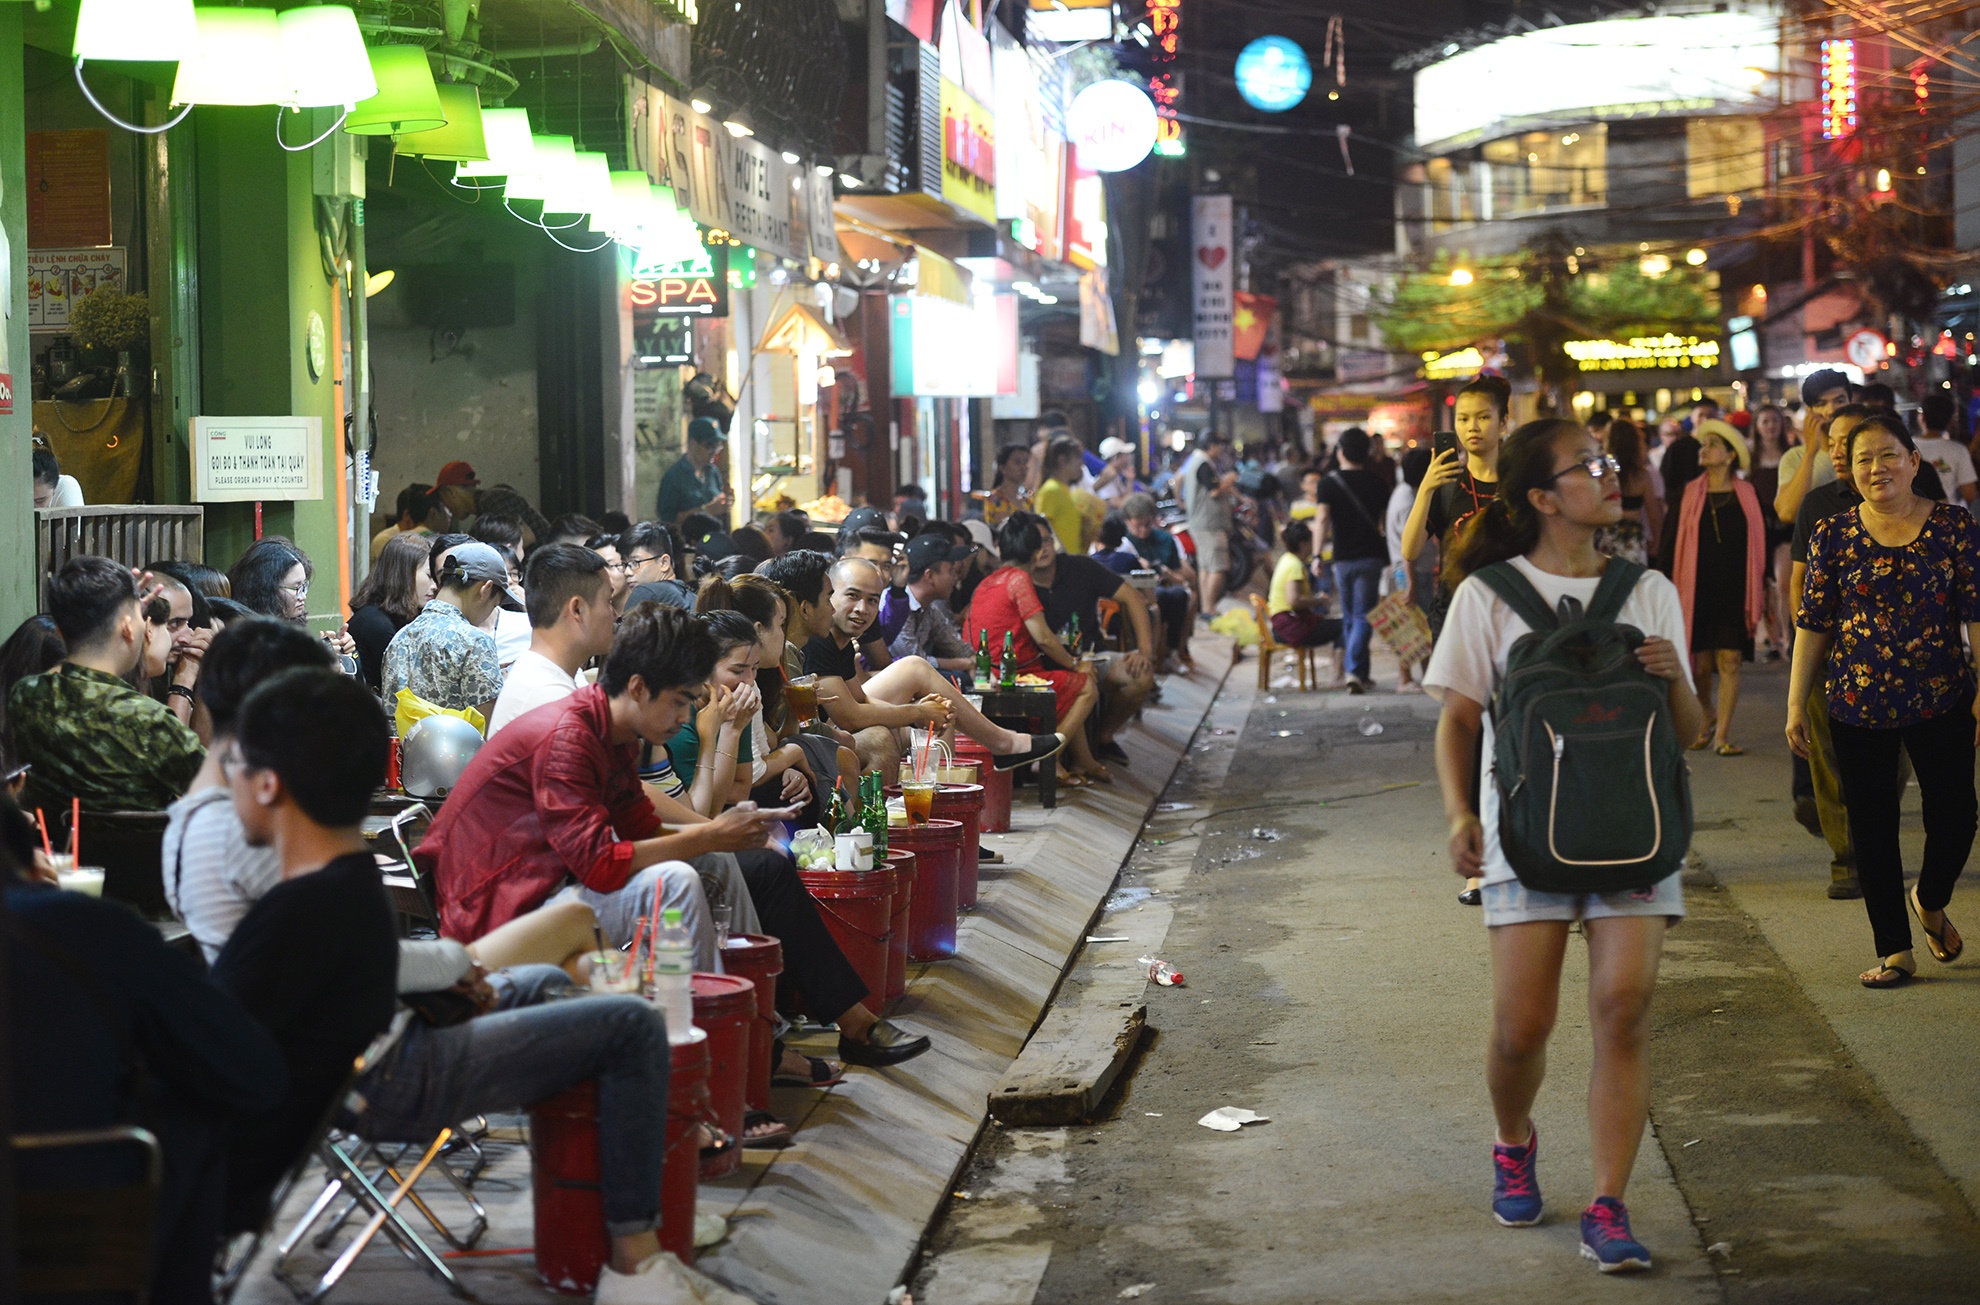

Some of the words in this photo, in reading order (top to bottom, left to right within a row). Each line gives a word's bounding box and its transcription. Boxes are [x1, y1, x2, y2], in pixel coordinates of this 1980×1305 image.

[734, 147, 770, 201] HOTEL
[734, 201, 789, 248] RESTAURANT
[630, 278, 717, 305] SPA
[244, 435, 255, 450] VUI
[239, 456, 259, 470] THANH
[215, 476, 233, 484] PLEASE
[234, 476, 250, 484] ORDER
[251, 476, 261, 484] AND
[262, 476, 272, 484] PAY
[273, 476, 280, 484] AT
[281, 475, 303, 484] COUNTER
